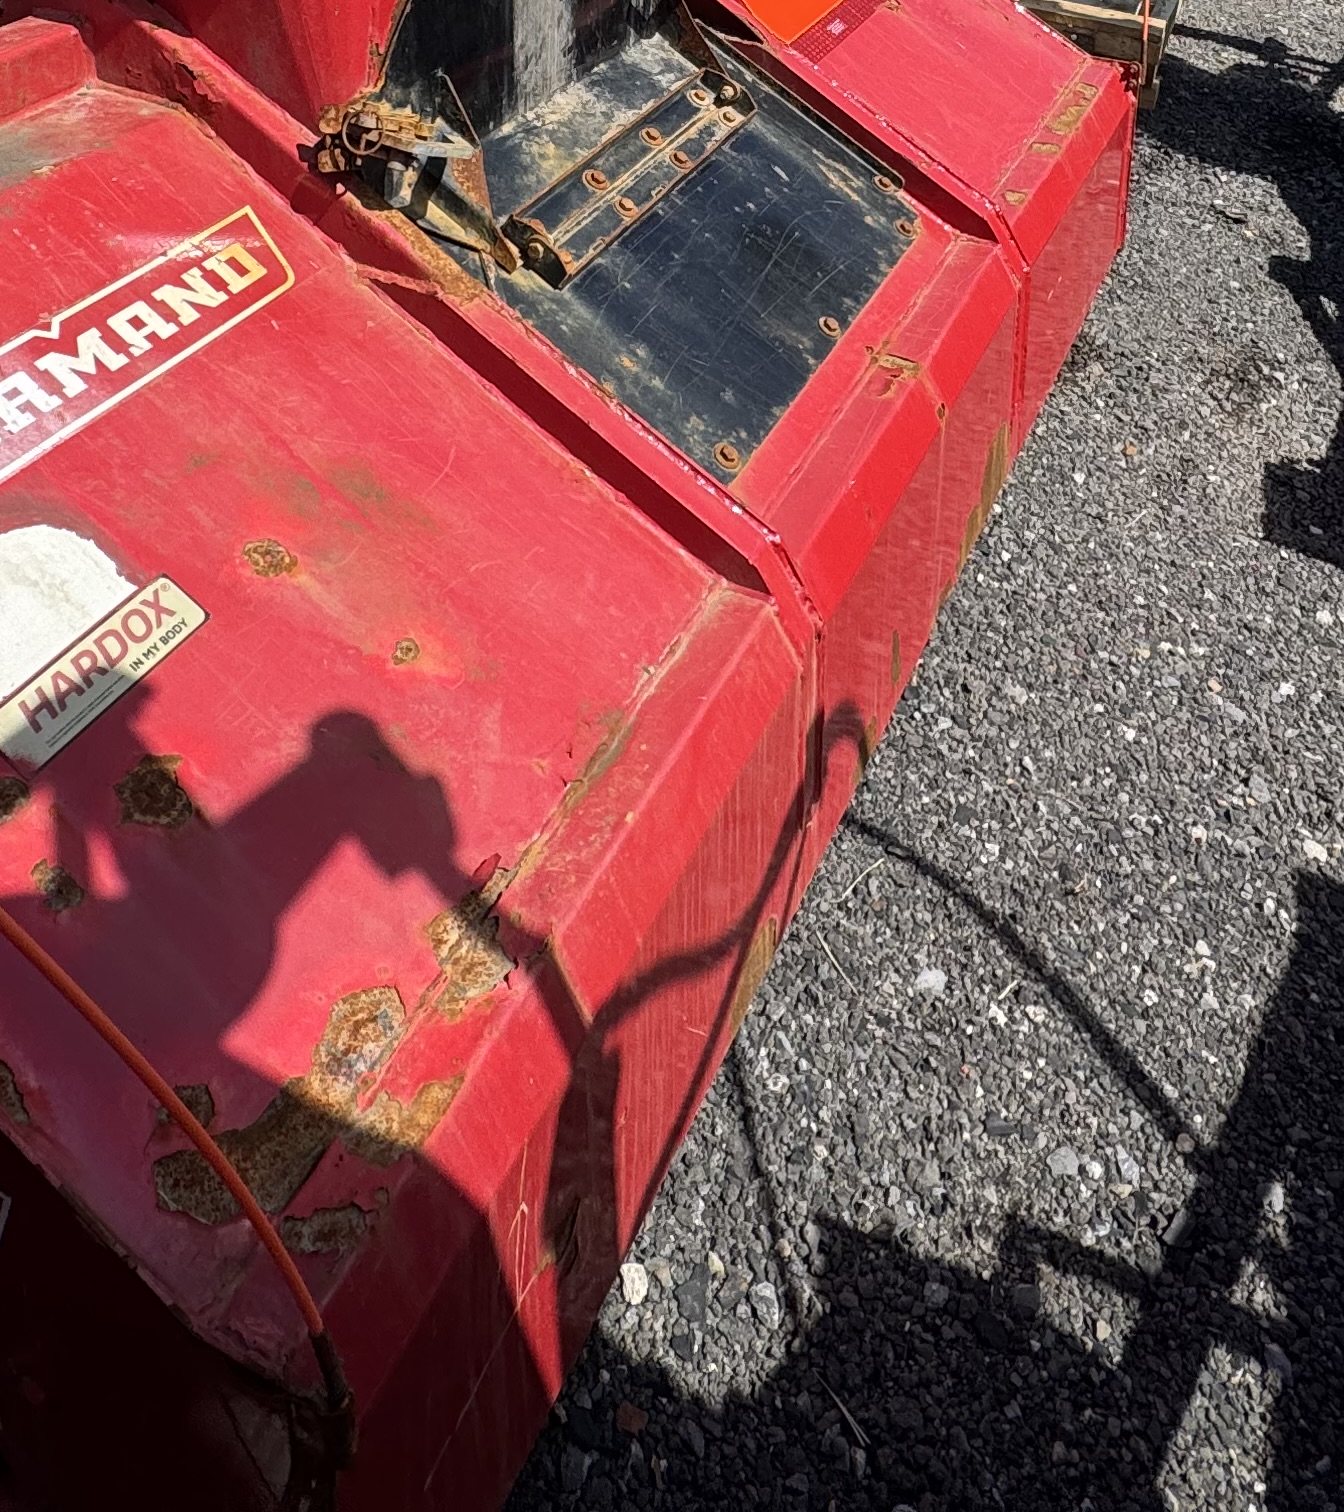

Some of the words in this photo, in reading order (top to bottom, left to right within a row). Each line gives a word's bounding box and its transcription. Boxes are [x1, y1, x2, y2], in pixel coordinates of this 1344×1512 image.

[18, 588, 176, 733] HARDOX
[129, 658, 144, 672] IN
[143, 642, 160, 660] MY
[159, 618, 188, 645] BODY
